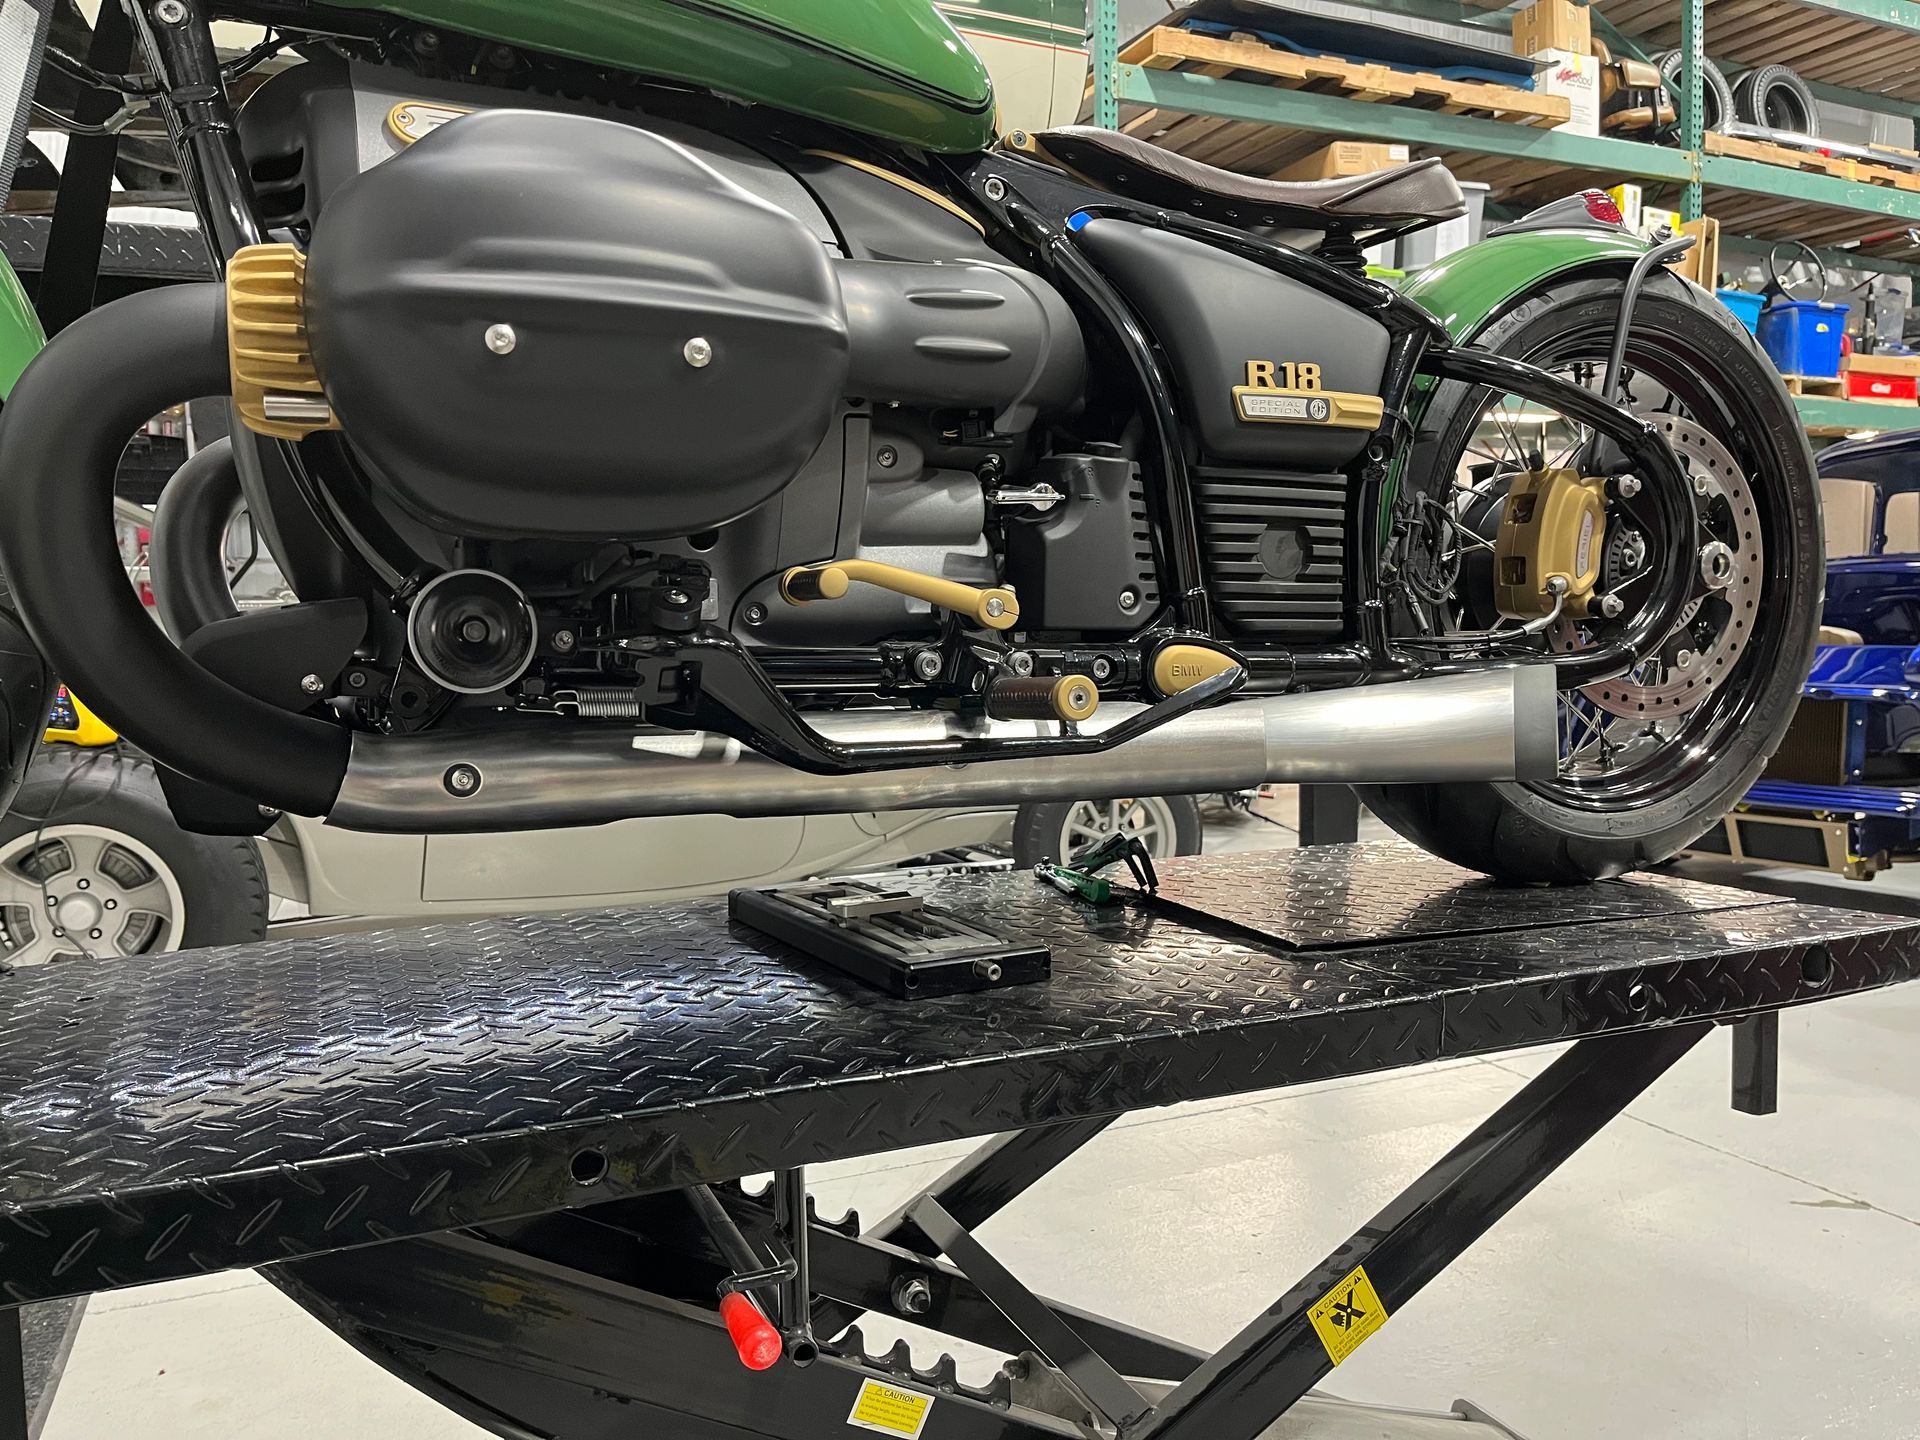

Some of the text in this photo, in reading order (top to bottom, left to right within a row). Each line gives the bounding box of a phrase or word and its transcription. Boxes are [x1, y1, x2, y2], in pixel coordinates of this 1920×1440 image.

[1251, 399, 1301, 407] SPECIAL
[1251, 406, 1301, 414] EDITION
[1171, 664, 1204, 677] BMW
[1323, 1282, 1352, 1309] CAUTION
[884, 1390, 915, 1404] CAUTION
